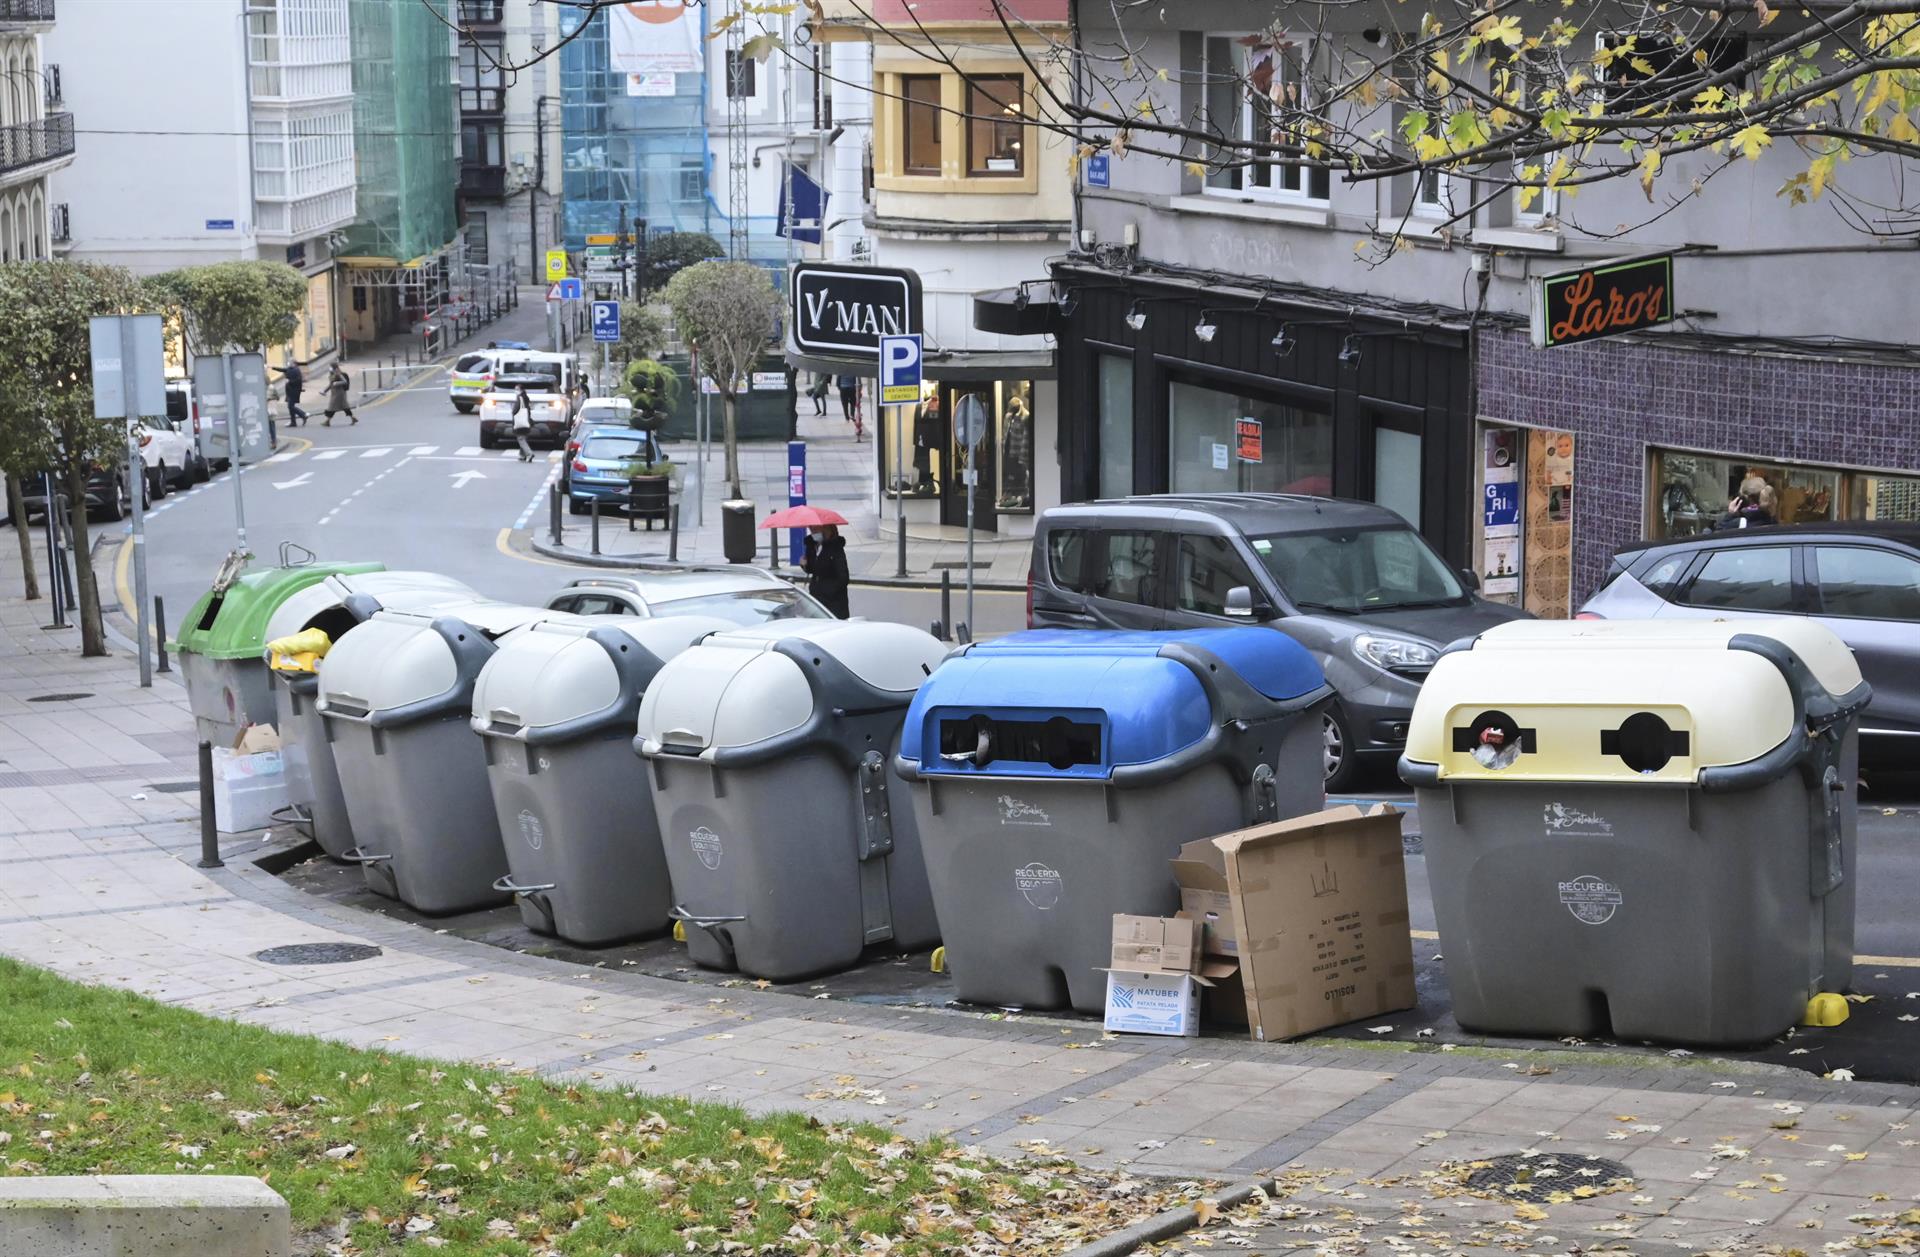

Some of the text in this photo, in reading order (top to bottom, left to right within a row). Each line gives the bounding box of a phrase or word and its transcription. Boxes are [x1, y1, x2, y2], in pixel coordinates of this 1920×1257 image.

[594, 305, 610, 325] P
[883, 339, 919, 385] P
[1486, 485, 1497, 498] G
[1486, 512, 1495, 524] T
[1558, 882, 1620, 892] RECUERD
[1137, 988, 1179, 998] NATUBER
[1324, 984, 1356, 1000] ROSILLO
